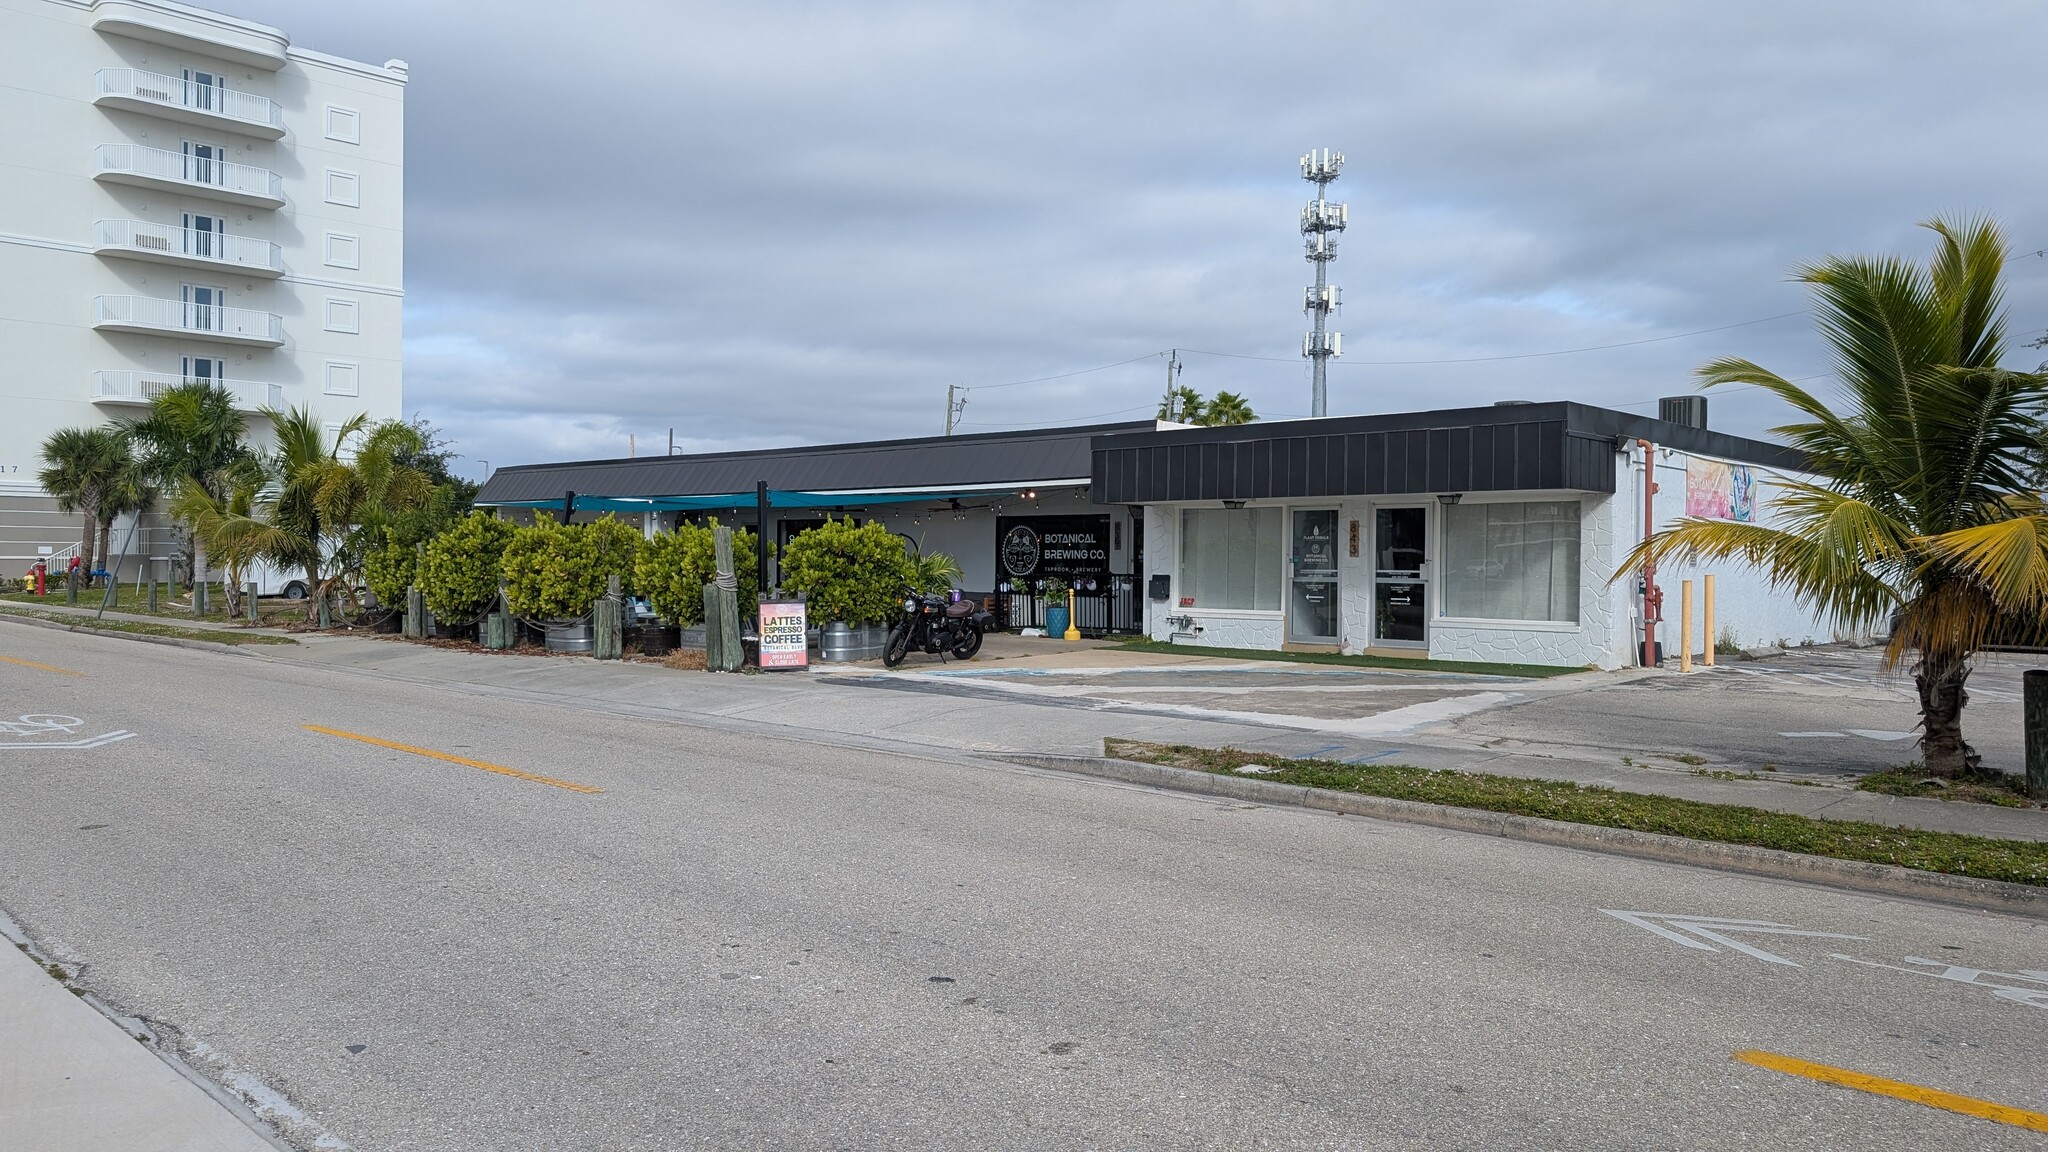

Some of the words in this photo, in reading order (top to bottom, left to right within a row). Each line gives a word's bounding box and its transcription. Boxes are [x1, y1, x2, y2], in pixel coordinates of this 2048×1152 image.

[1044, 533, 1097, 544] BOTANICAL
[1044, 549, 1088, 560] BREWING
[1089, 549, 1106, 560] CO.
[763, 617, 803, 626] LATTES
[764, 626, 803, 634] ESPRESSO
[764, 634, 803, 644] COFFEE
